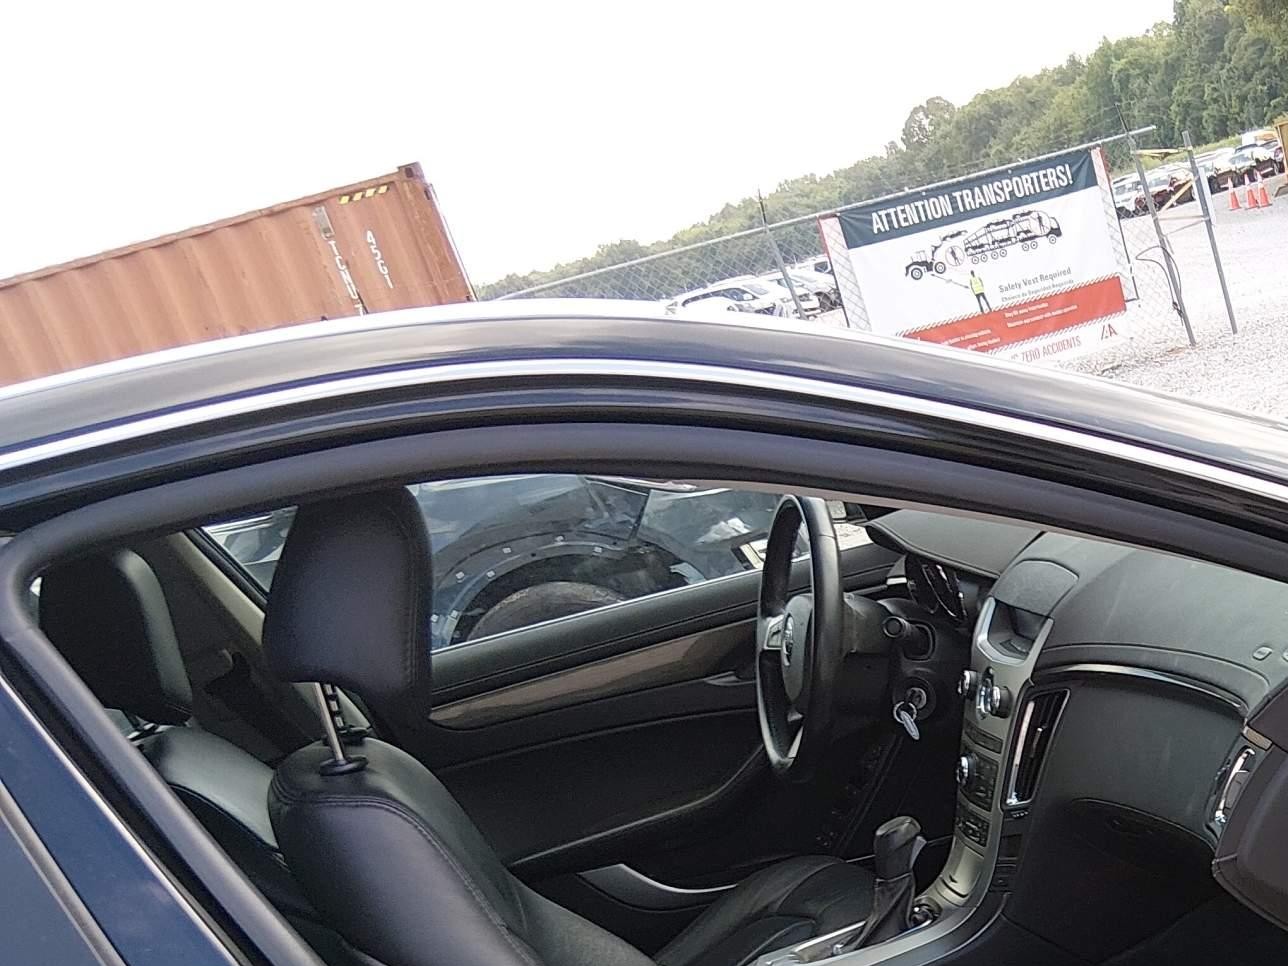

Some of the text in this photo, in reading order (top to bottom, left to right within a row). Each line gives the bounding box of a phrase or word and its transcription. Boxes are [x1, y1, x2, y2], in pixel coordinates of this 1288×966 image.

[871, 164, 1073, 234] ATTENTION TRANSPORTERS!
[998, 267, 1072, 293] Safety Vest Required
[1042, 336, 1082, 357] ACCIDENTS
